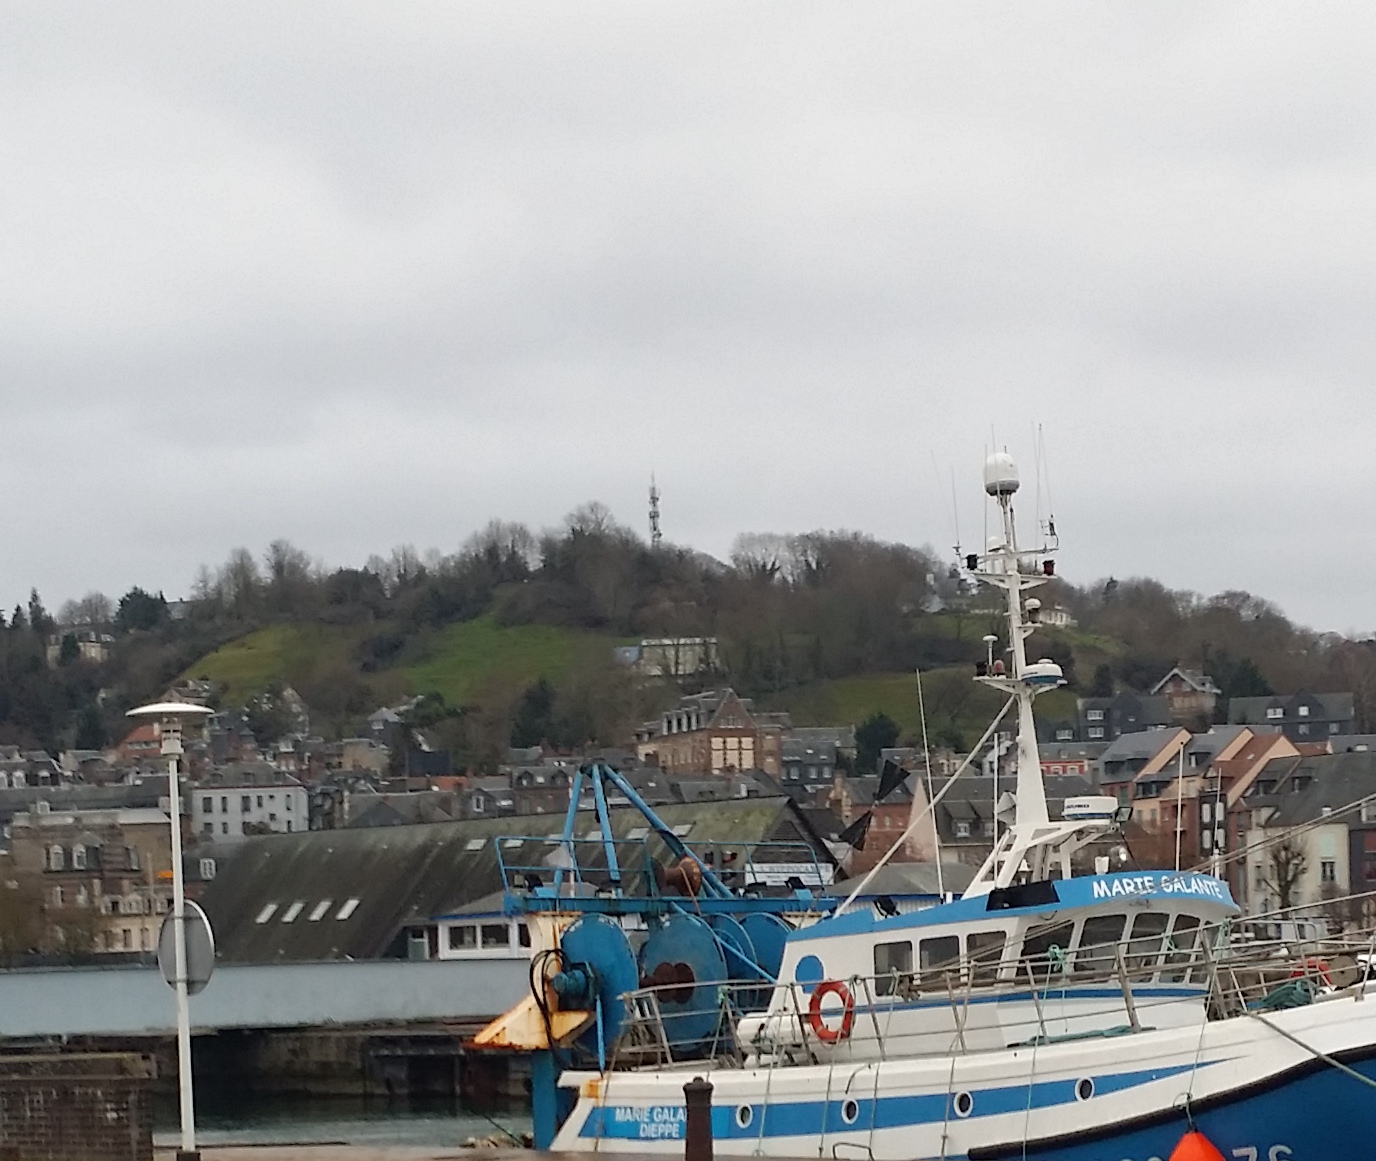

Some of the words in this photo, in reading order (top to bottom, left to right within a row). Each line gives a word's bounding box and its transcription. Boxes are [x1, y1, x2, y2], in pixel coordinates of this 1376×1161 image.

[1093, 876, 1157, 898] MARIE
[1161, 875, 1223, 899] GALANTE
[615, 1107, 651, 1121] MARIE
[653, 1107, 687, 1122] GALA
[639, 1123, 679, 1138] DIEPPE
